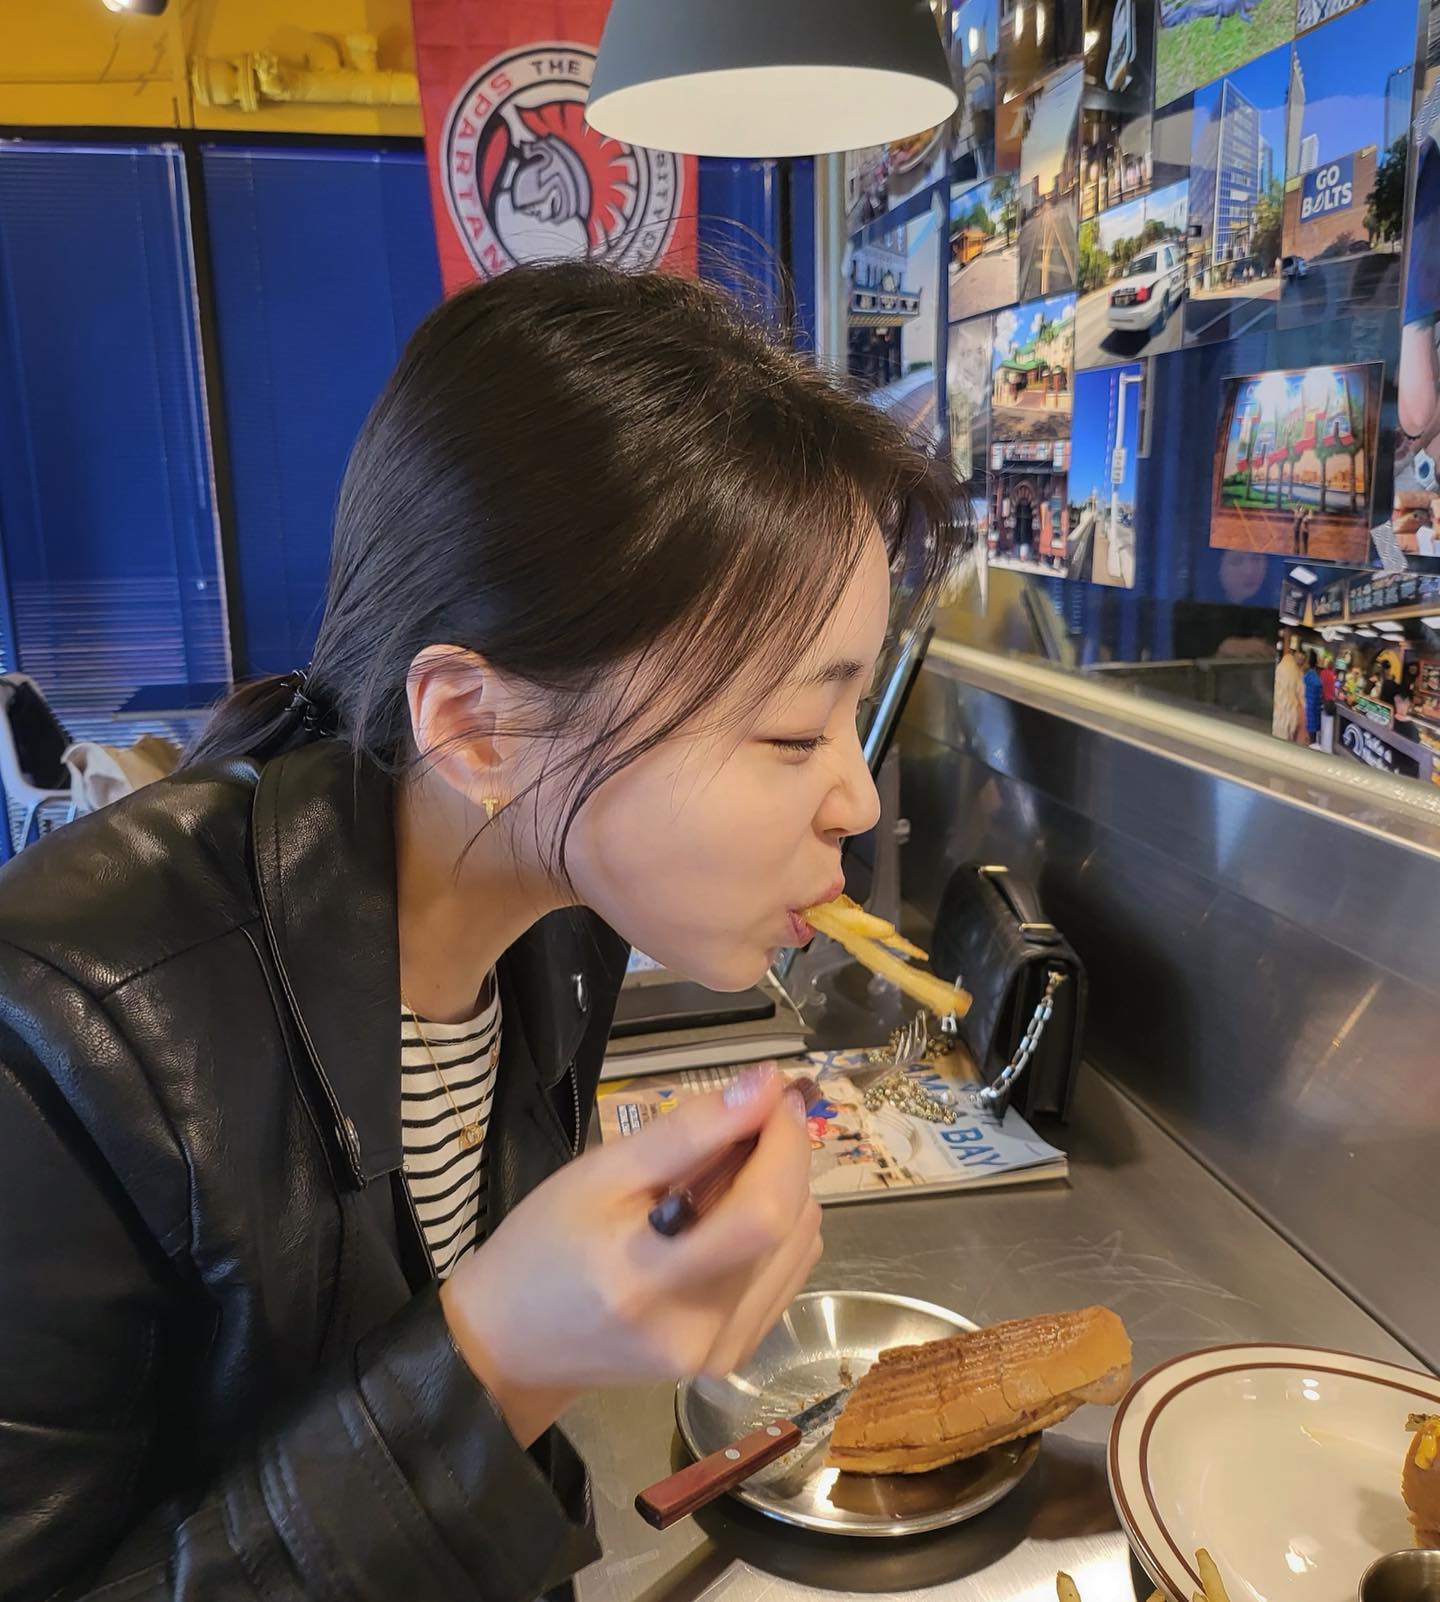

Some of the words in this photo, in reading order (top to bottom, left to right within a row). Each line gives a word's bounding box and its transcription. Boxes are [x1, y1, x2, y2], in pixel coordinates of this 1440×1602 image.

[530, 60, 582, 76] THE
[1316, 165, 1340, 191] GO
[1301, 182, 1353, 219] BOLTS
[940, 1127, 1009, 1167] BAY
